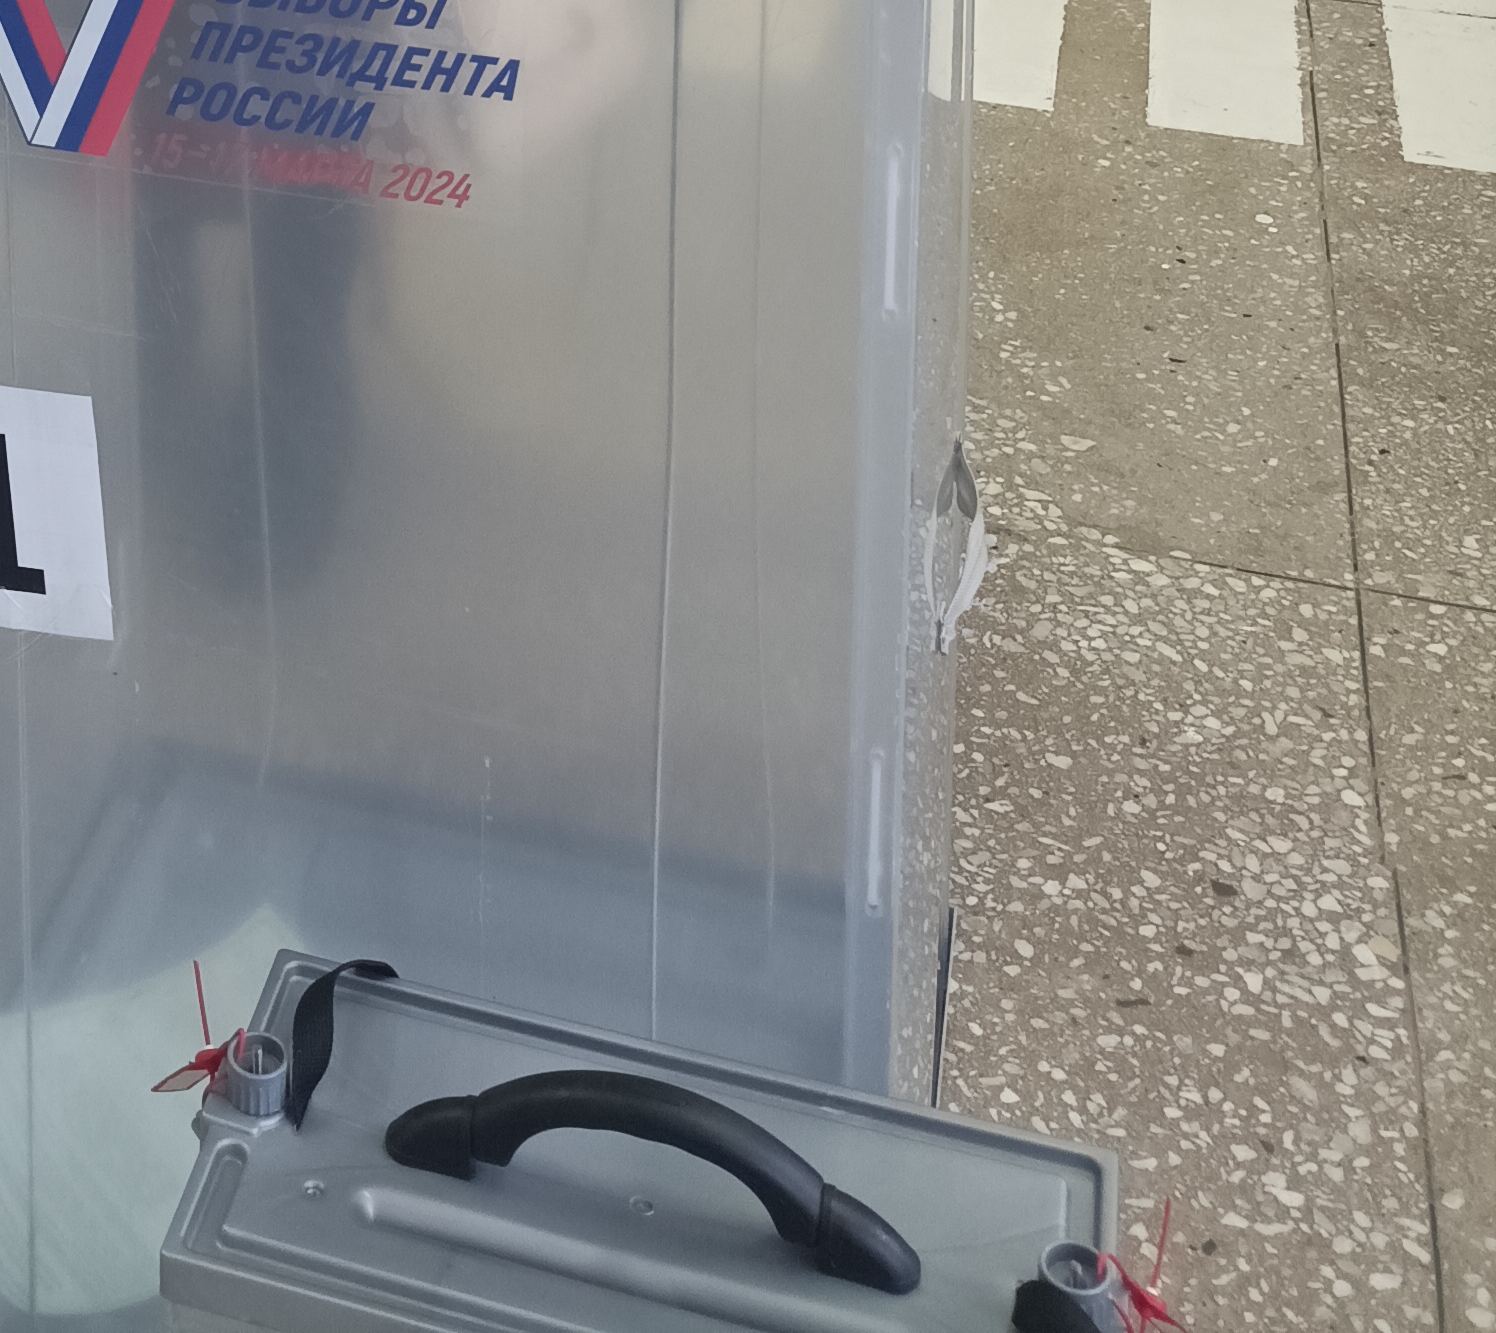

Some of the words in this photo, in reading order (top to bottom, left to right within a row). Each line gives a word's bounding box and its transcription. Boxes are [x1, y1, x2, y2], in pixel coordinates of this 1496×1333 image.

[190, 20, 521, 102] ПРЕЗИДЕНТА
[165, 76, 376, 142] РОССИИ
[379, 163, 472, 209] 2024
